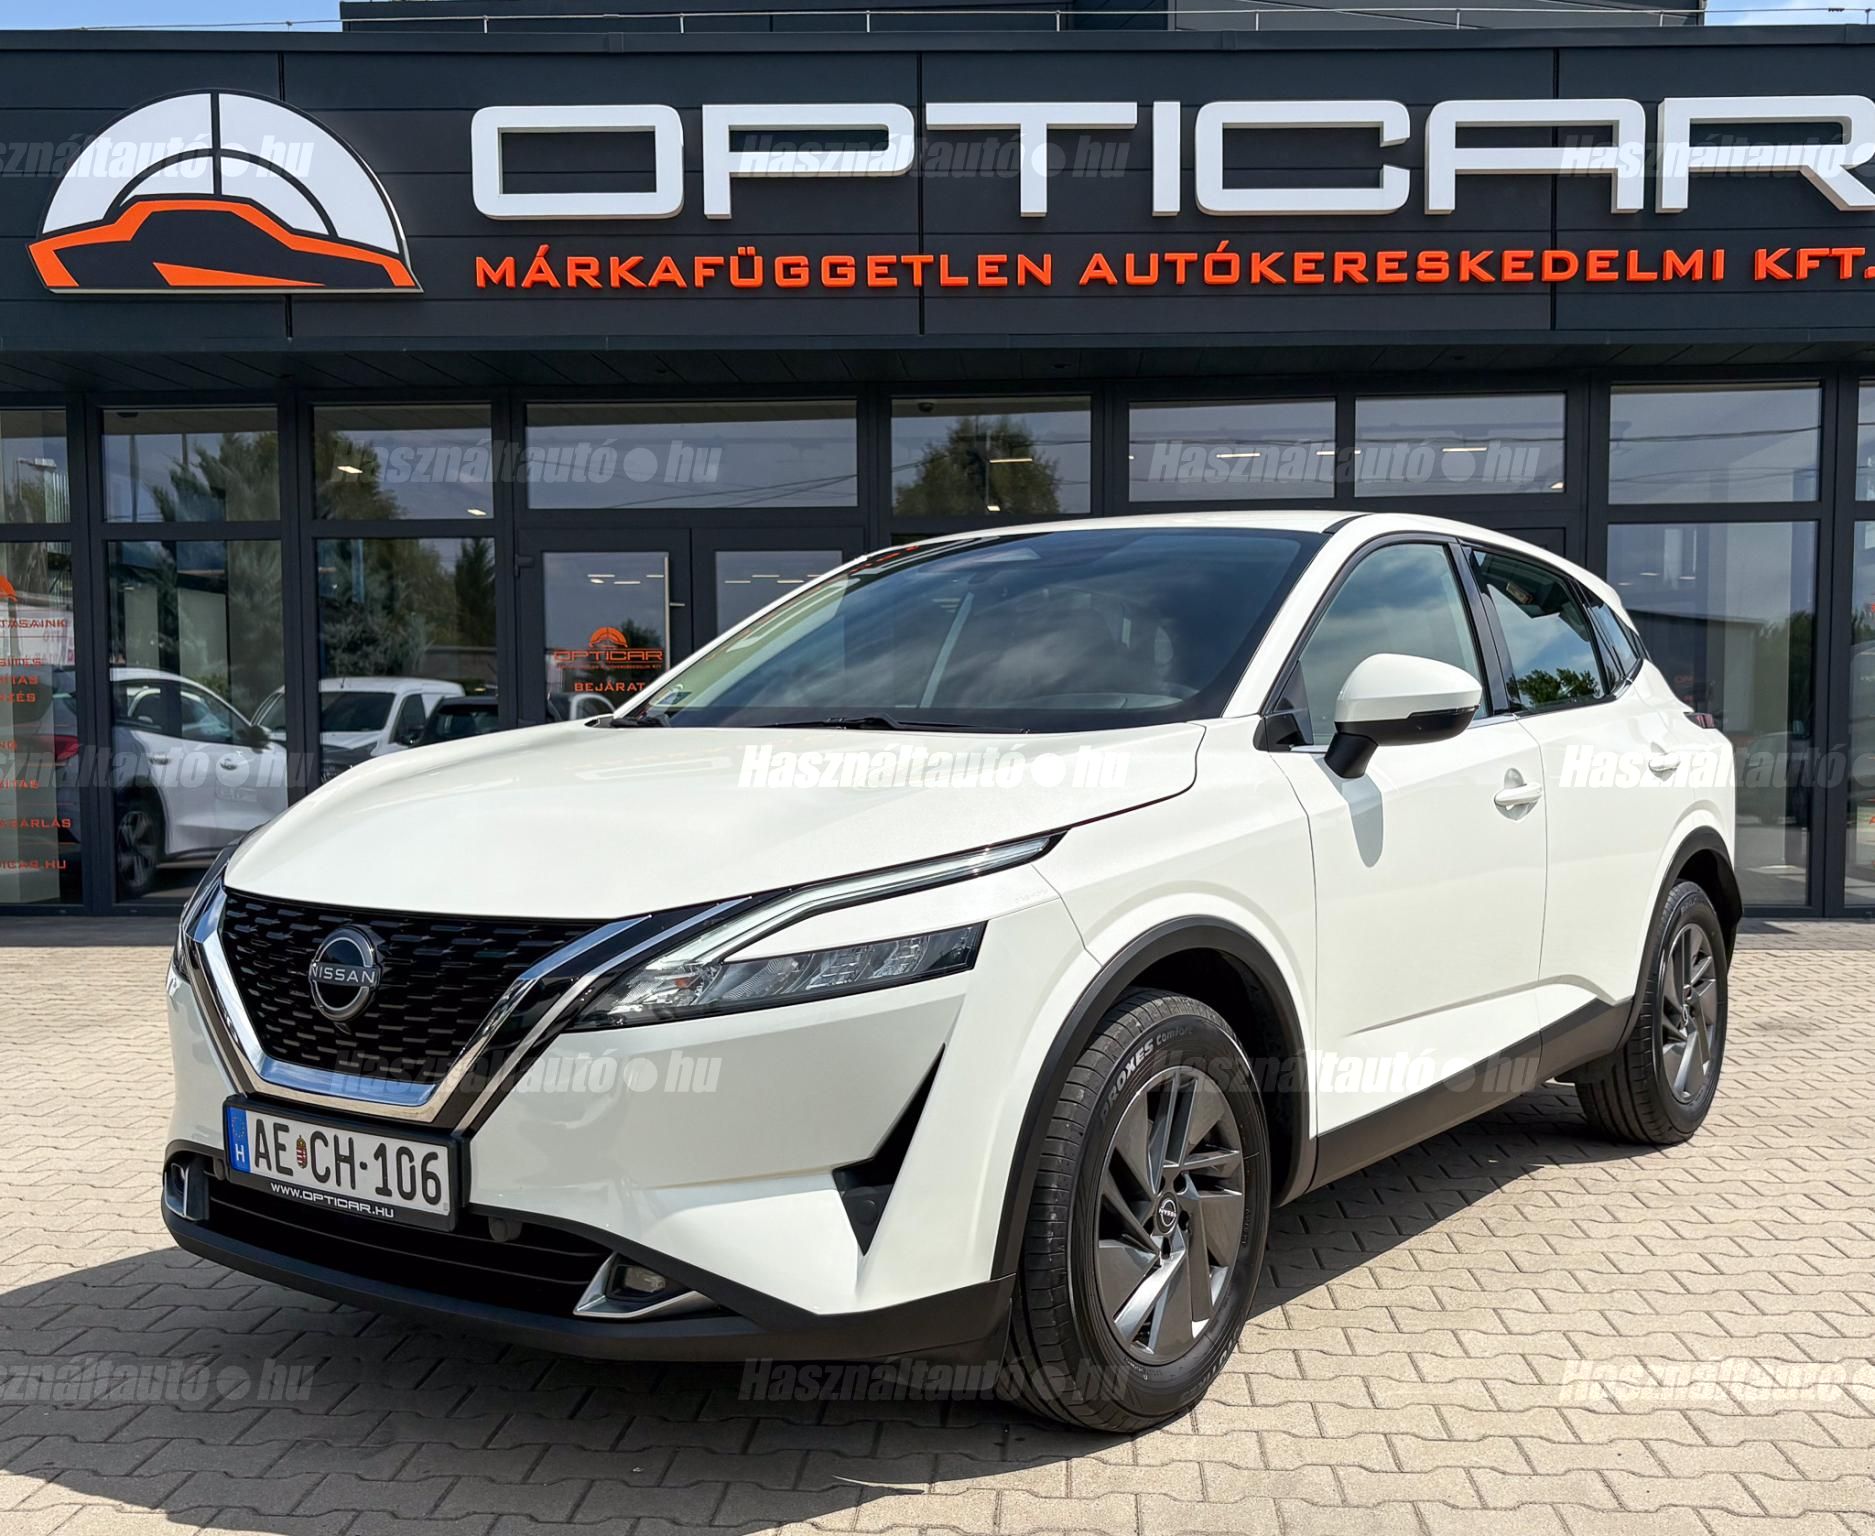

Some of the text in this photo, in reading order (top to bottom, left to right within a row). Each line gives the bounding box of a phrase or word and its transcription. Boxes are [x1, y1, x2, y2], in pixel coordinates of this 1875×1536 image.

[471, 95, 1875, 219] OPTICAR
[475, 243, 1053, 289] MÁRKAFÜGGETLEN
[1078, 239, 1726, 286] AUTÓKERESKEDELMI
[554, 650, 663, 661] OPTICAR
[574, 676, 646, 692] BEJÁRAT
[312, 965, 375, 984] NISSAN
[234, 1144, 245, 1164] H
[254, 1118, 294, 1177] AE
[270, 1182, 395, 1219] WWW.OPTICAR.HU
